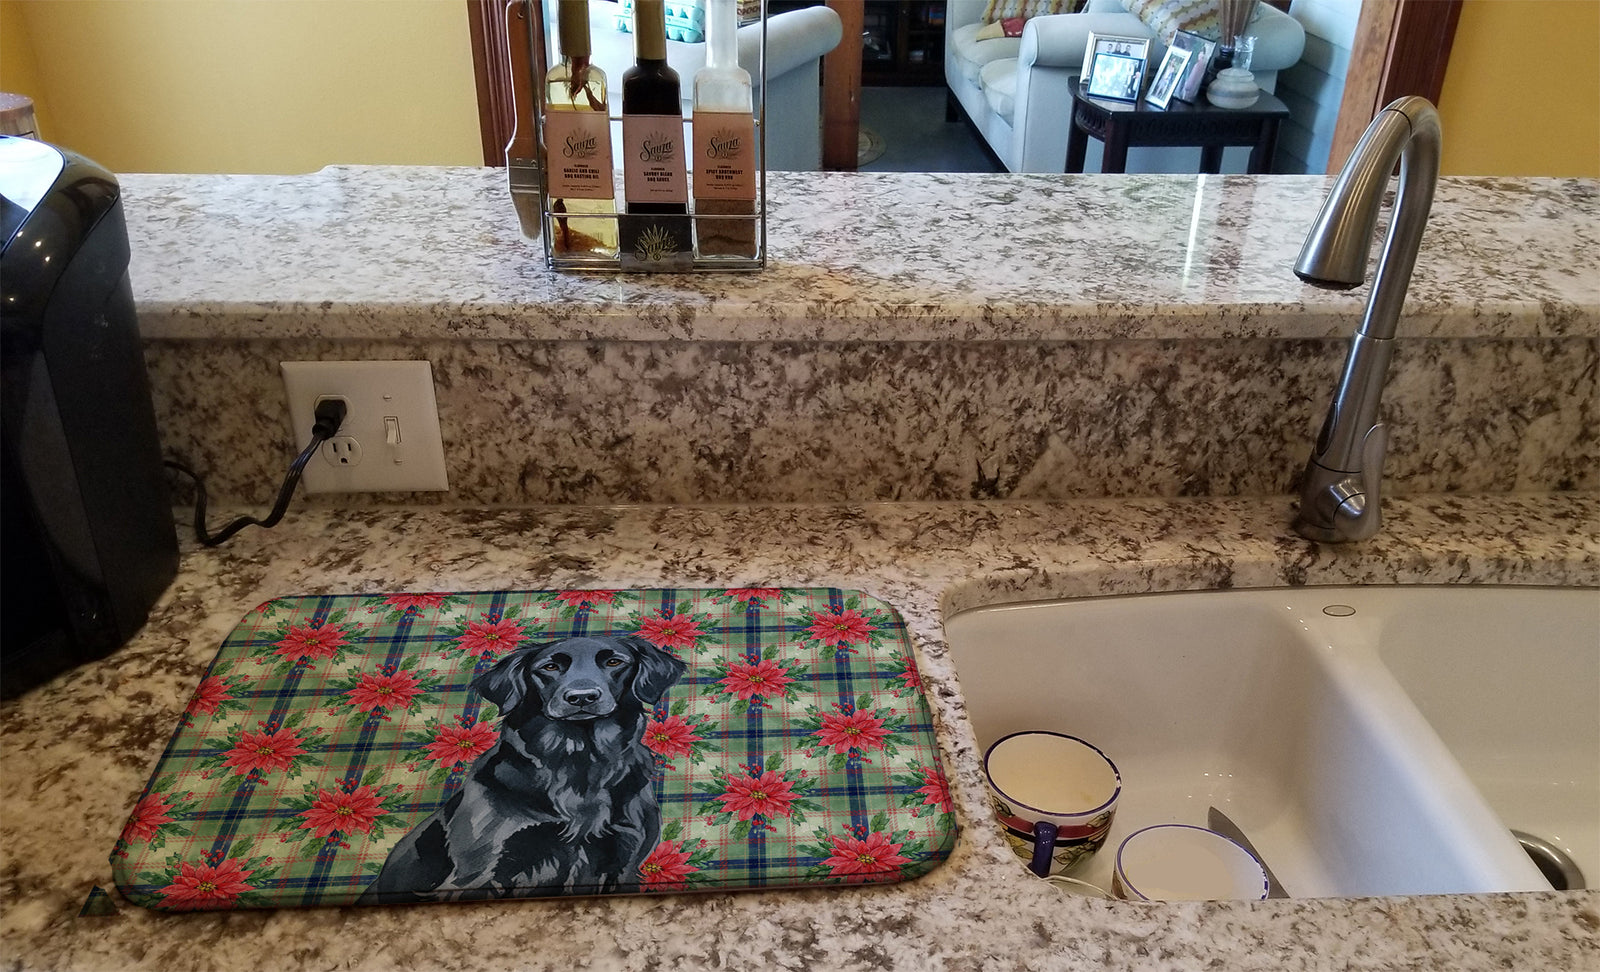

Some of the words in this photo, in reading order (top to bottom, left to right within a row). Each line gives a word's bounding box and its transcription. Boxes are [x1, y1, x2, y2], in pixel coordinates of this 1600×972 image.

[563, 136, 597, 158] Sauza
[640, 140, 673, 162] Sauza
[707, 137, 740, 159] Sauza
